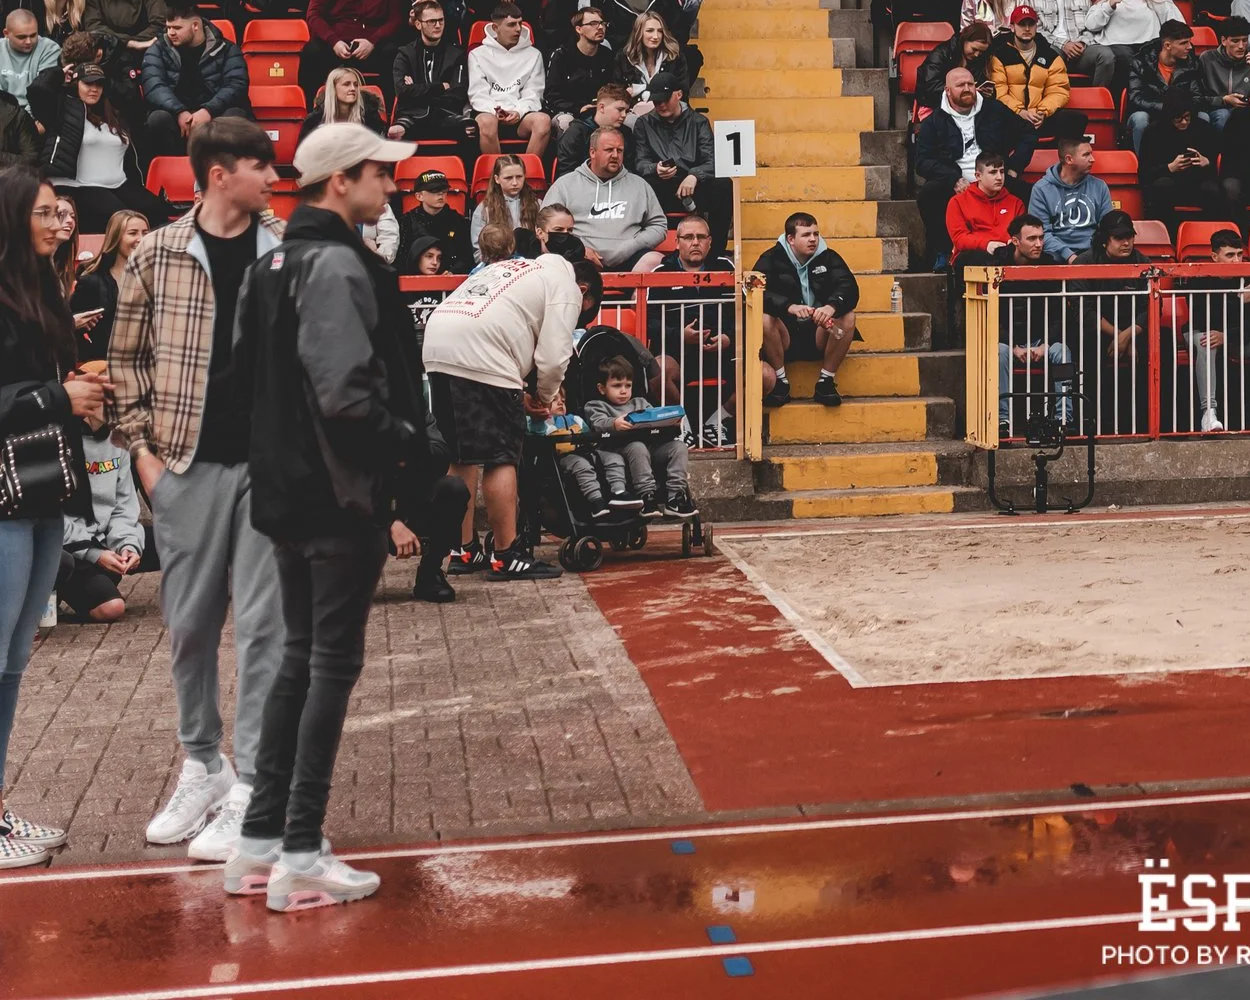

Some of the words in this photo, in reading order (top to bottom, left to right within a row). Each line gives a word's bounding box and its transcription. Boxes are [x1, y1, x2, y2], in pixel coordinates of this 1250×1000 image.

[725, 131, 742, 166] 1
[588, 200, 628, 219] NIKE
[693, 273, 712, 285] 34
[89, 457, 120, 475] MARI
